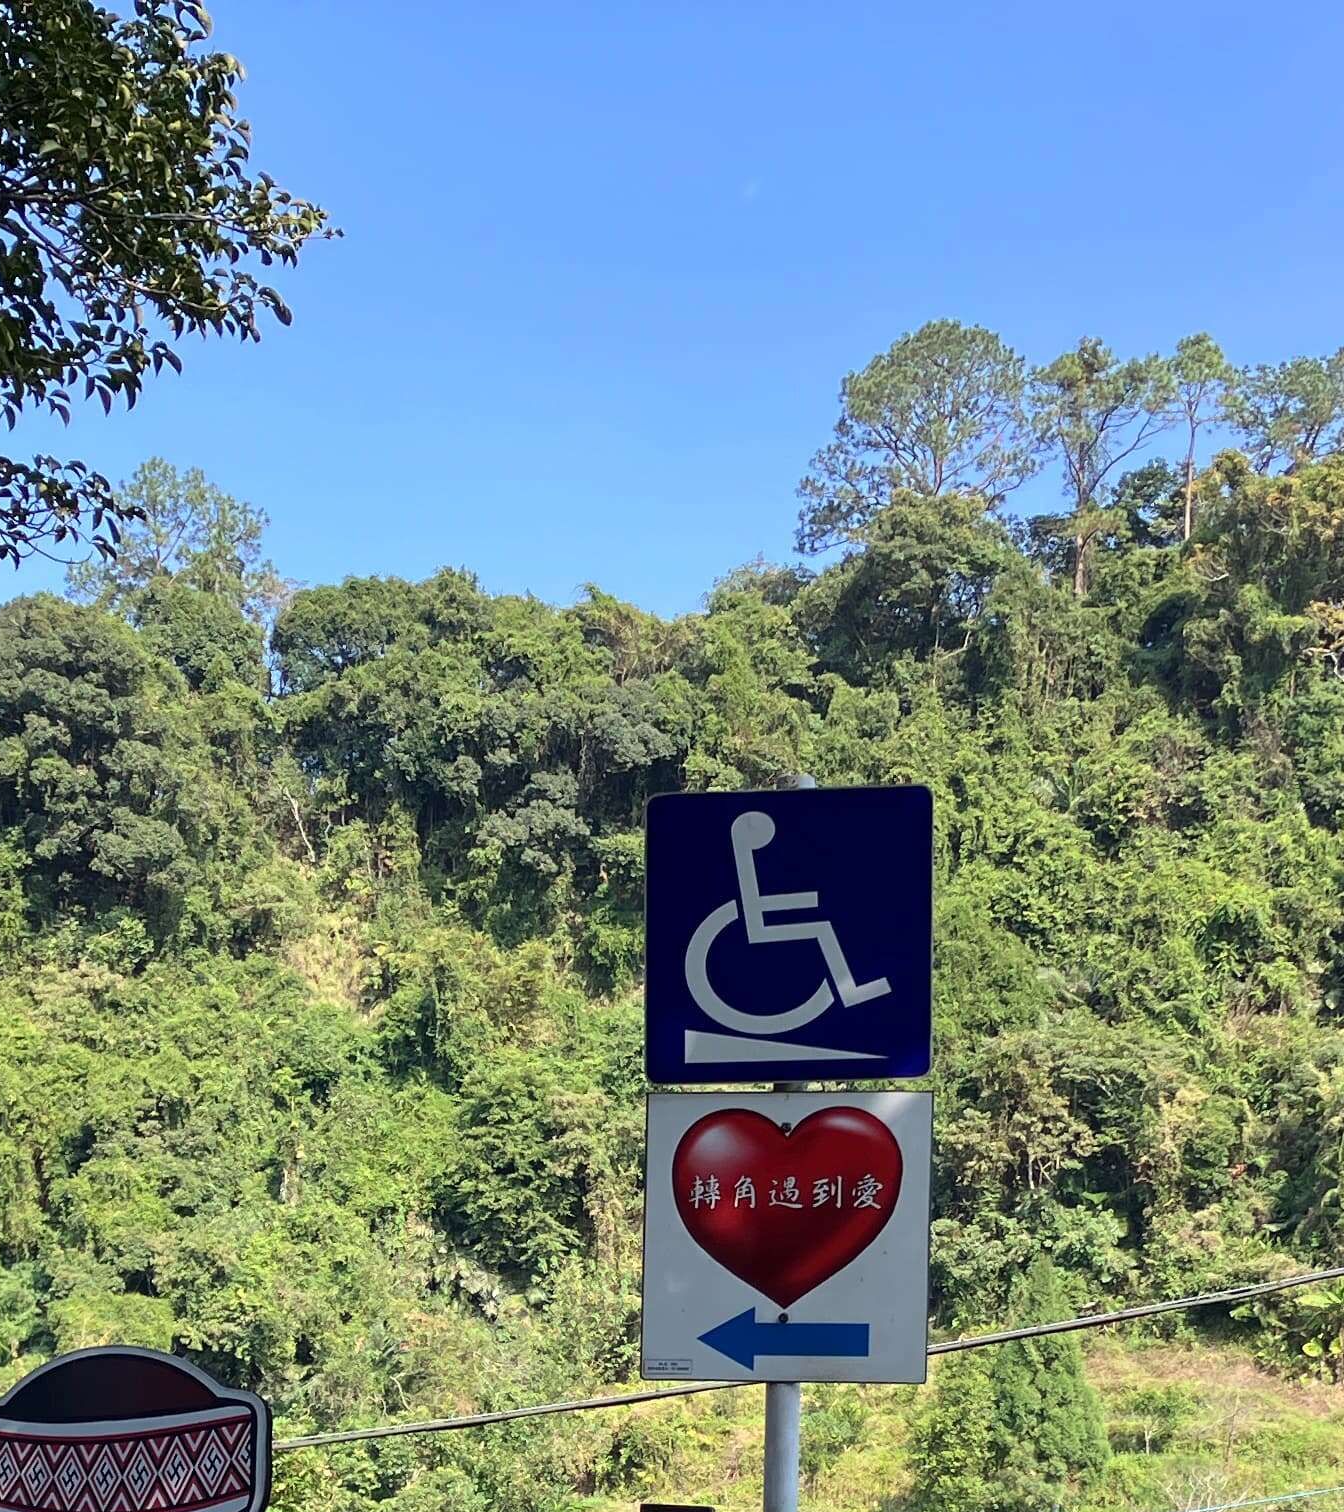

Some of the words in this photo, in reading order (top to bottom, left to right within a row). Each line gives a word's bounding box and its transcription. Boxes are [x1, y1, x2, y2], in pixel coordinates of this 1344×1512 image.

[688, 1174, 884, 1210] 轉角遇到愛
